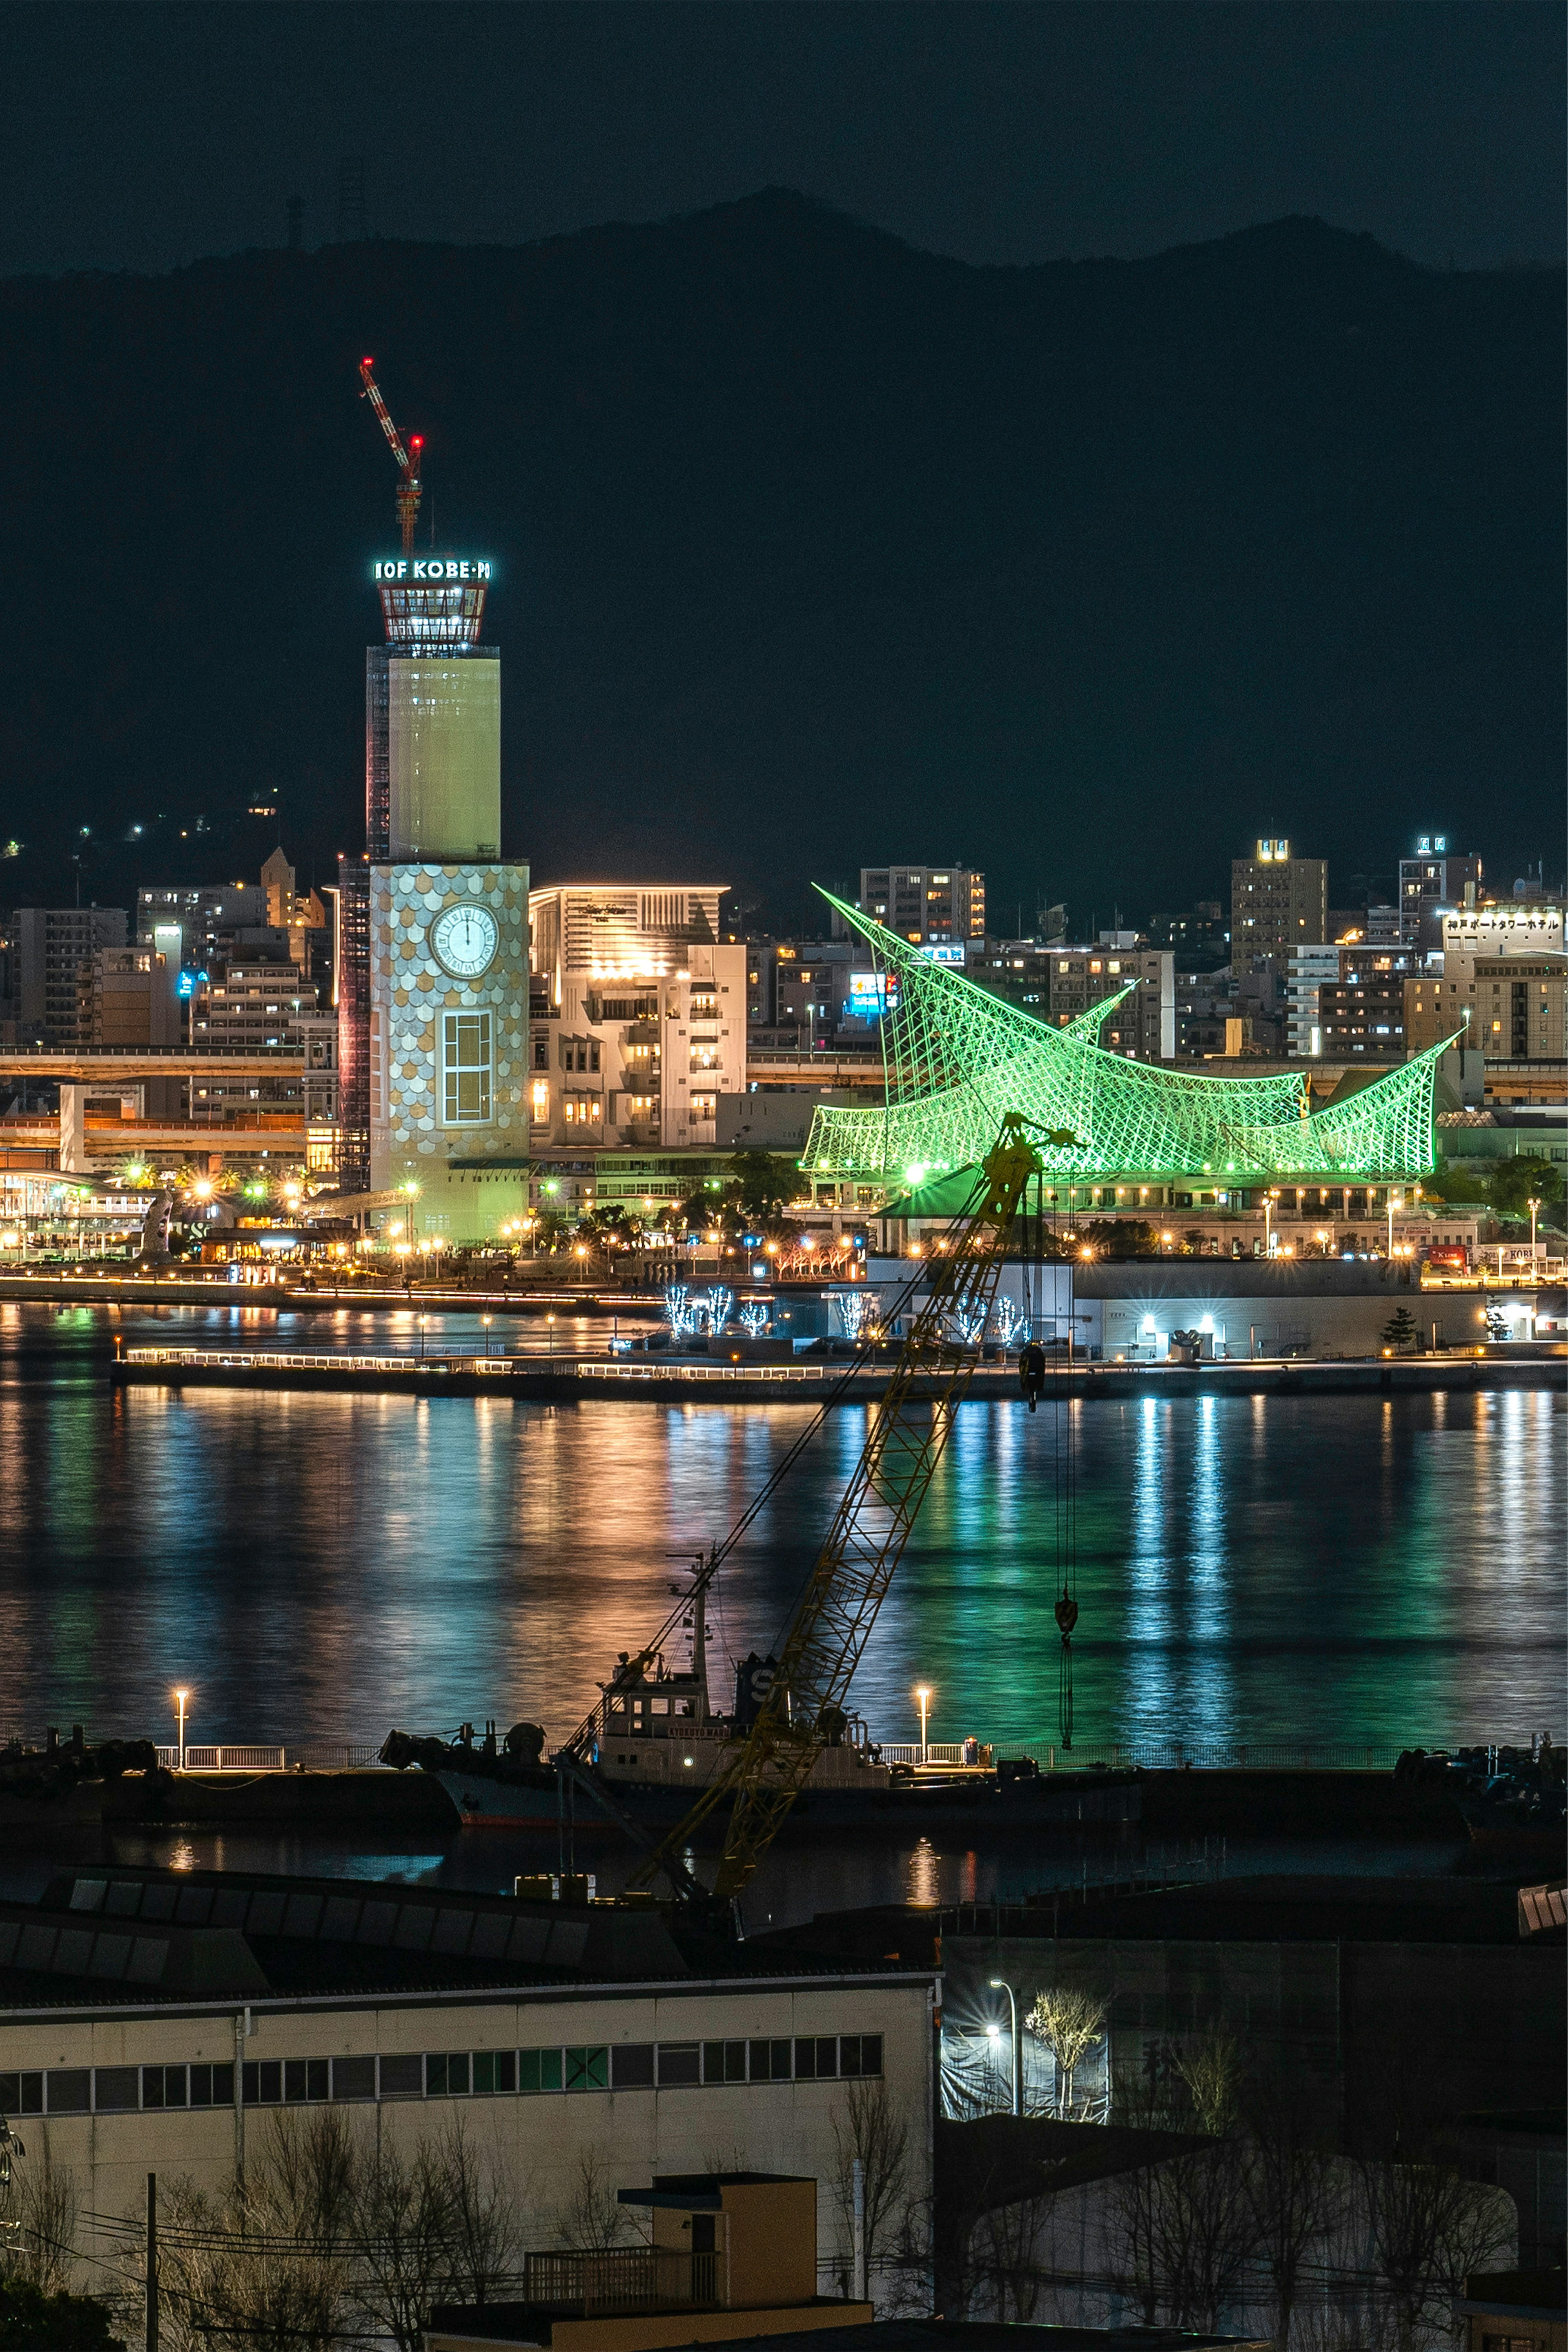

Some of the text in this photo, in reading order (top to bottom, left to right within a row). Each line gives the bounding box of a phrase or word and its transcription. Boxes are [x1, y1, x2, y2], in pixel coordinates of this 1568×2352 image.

[1448, 919, 1559, 931] 神戸ポートタワーホテル
[706, 1727, 730, 1737] MARU
